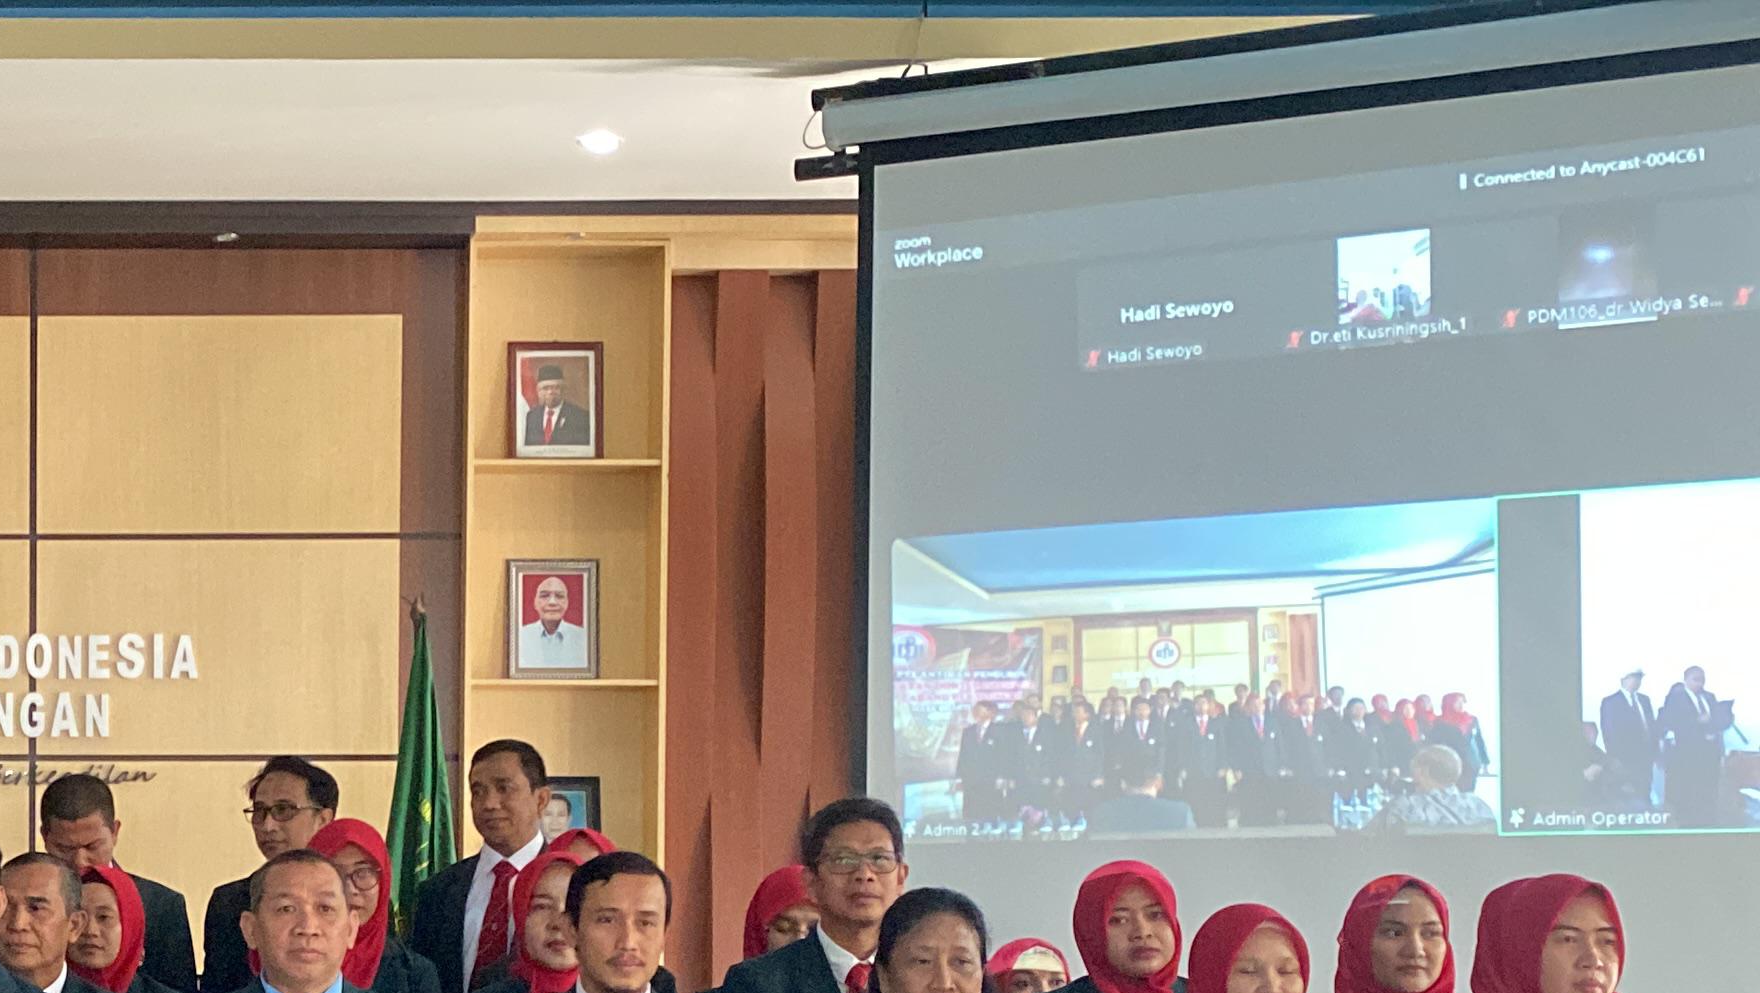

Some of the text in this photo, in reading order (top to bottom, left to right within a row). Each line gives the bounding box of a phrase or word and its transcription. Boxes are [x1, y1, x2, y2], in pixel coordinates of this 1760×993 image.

[1474, 148, 1705, 188] Connected to Anycast-004C61
[895, 236, 932, 250] zoom
[895, 246, 984, 268] Workplace
[1120, 300, 1234, 323] Hadi Sewoyo
[1629, 295, 1682, 315] Widya
[1108, 344, 1203, 364] Hadi Sewoyo
[1533, 809, 1672, 828] Admin Operator
[923, 823, 968, 838] Admin
